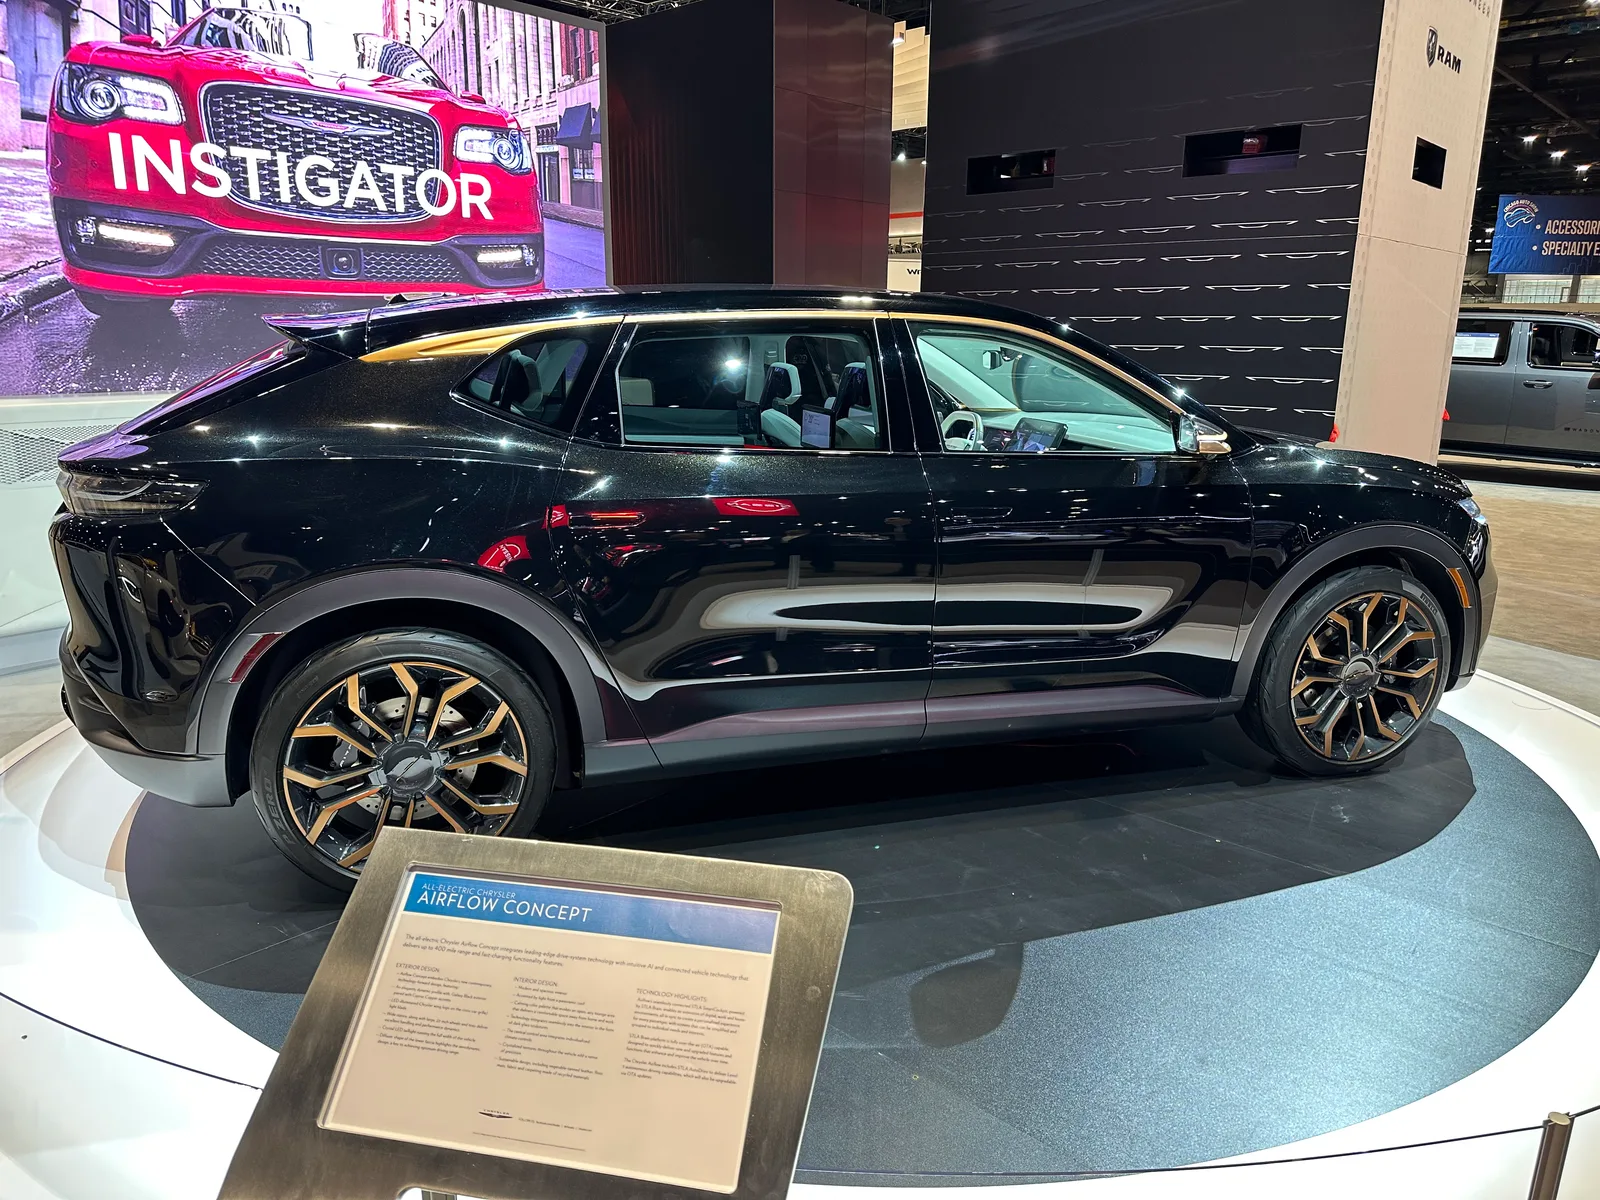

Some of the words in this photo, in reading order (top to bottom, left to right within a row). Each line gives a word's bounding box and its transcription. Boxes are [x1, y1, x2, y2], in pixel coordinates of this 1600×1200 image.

[1469, 0, 1490, 18] NEER
[1437, 44, 1462, 74] RAM
[108, 132, 494, 220] INSTIGATOR
[1544, 220, 1600, 234] ACCESSORI
[1542, 241, 1594, 256] SPECIALTY
[1593, 242, 1600, 256] E
[264, 778, 286, 831] ZERO
[422, 883, 474, 894] ALL-ELECTRIC
[477, 889, 516, 899] CHRYSLER
[417, 891, 499, 911] AIRFLOW
[504, 900, 592, 922] CONCEPT
[415, 935, 440, 944] all-electric
[438, 937, 460, 946] Chrysler
[478, 942, 500, 952] Concept
[524, 948, 556, 958] leading-edge
[555, 952, 587, 961] drive-system
[587, 957, 615, 966] technology
[709, 972, 738, 981] technology
[481, 951, 512, 962] fast-charging
[512, 954, 543, 965] functionality
